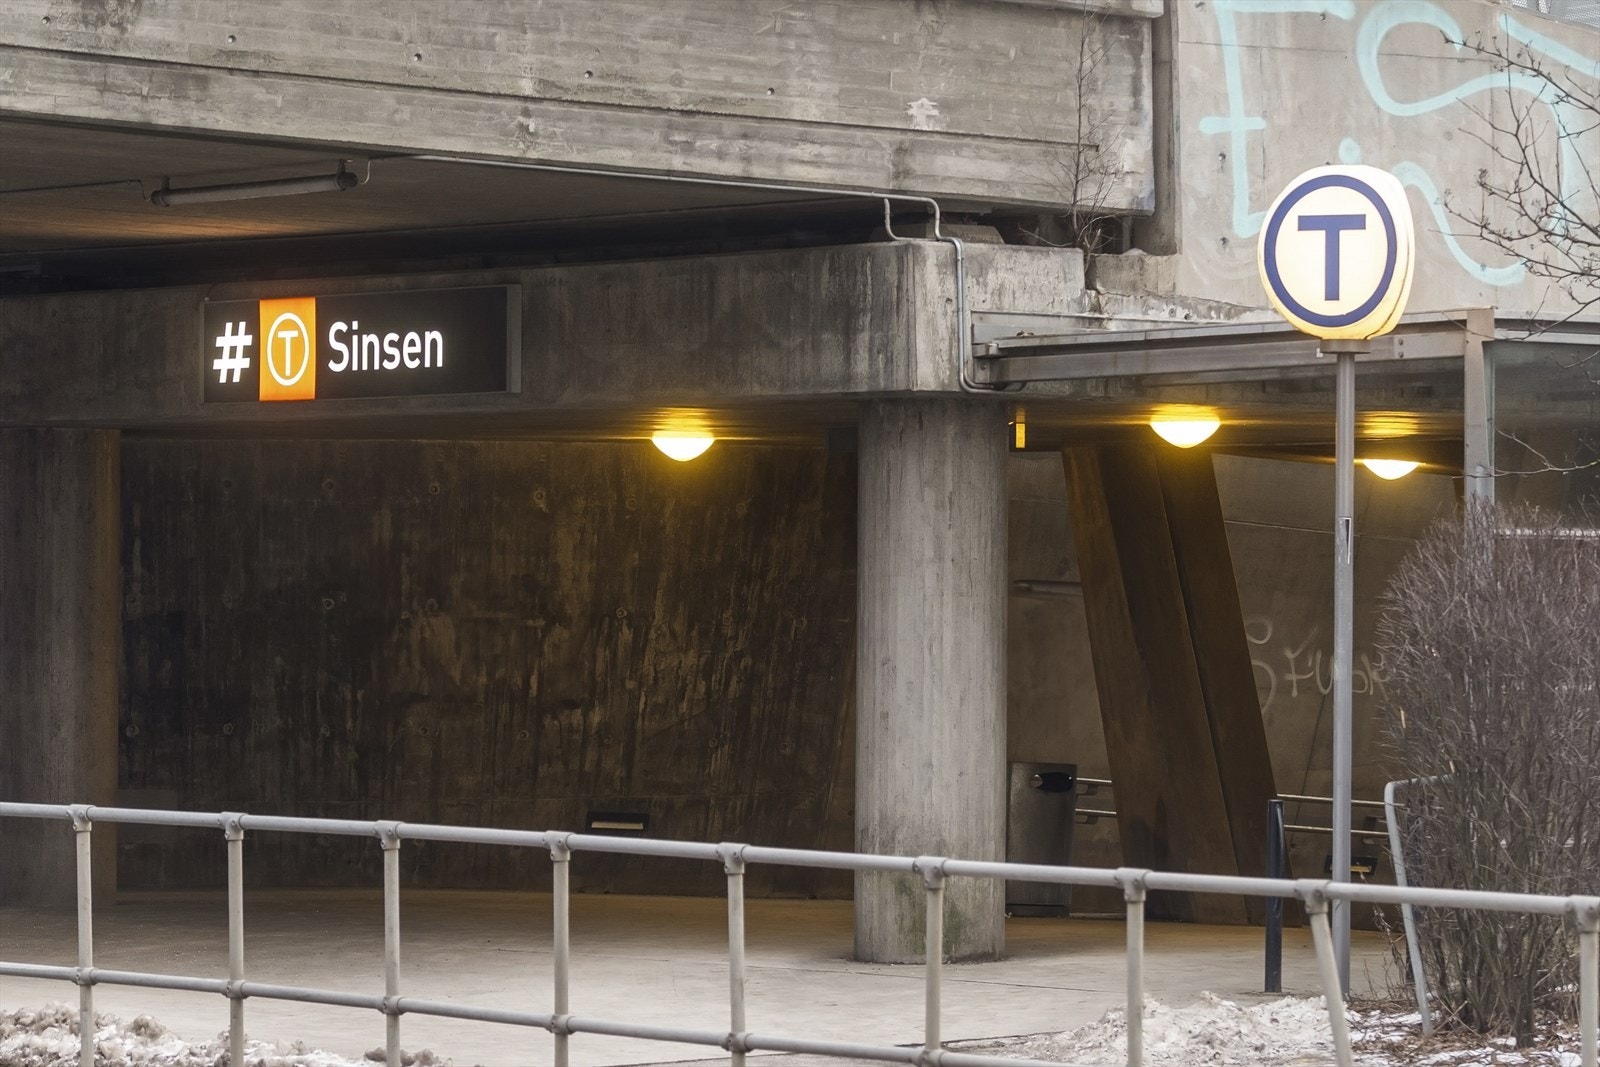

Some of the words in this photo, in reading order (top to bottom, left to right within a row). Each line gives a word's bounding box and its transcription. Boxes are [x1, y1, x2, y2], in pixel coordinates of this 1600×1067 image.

[1297, 214, 1366, 301] T
[277, 330, 298, 376] T
[328, 320, 443, 373] Sinsen
